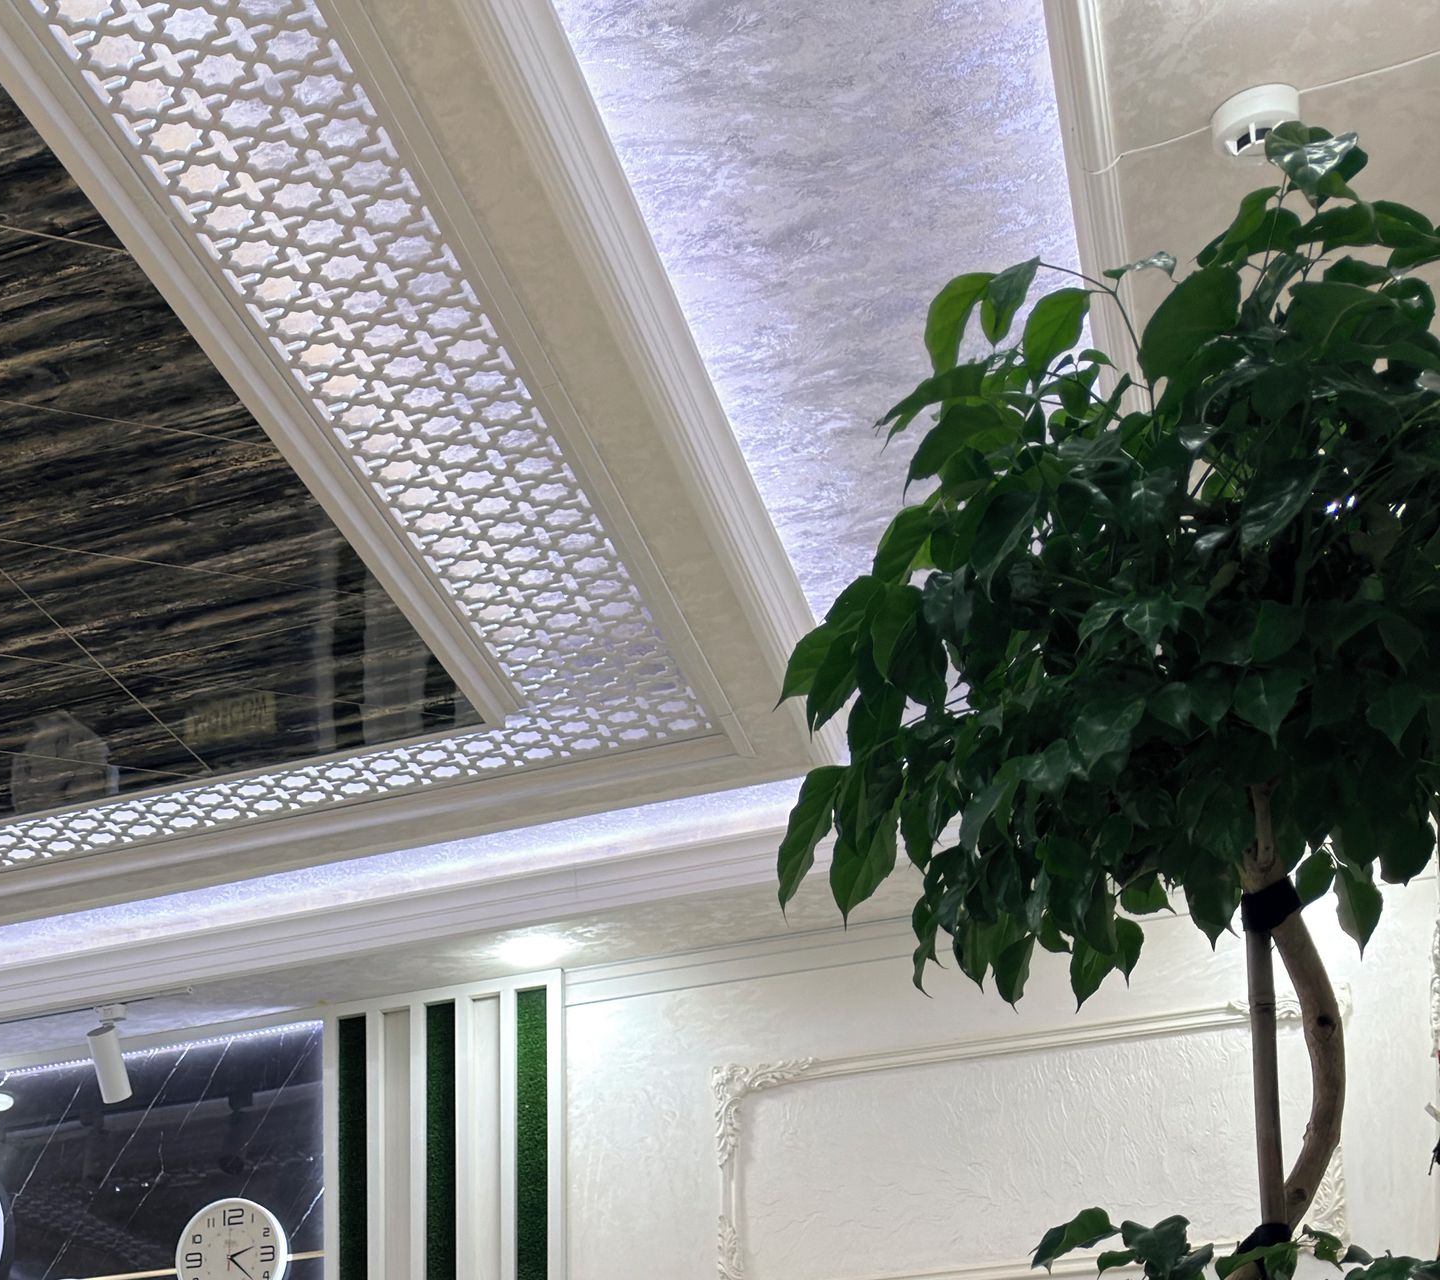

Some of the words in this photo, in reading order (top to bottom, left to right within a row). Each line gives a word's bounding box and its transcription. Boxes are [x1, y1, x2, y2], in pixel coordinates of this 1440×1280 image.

[223, 1208, 244, 1226] 12
[185, 1252, 202, 1269] 9
[260, 1245, 275, 1262] 3
